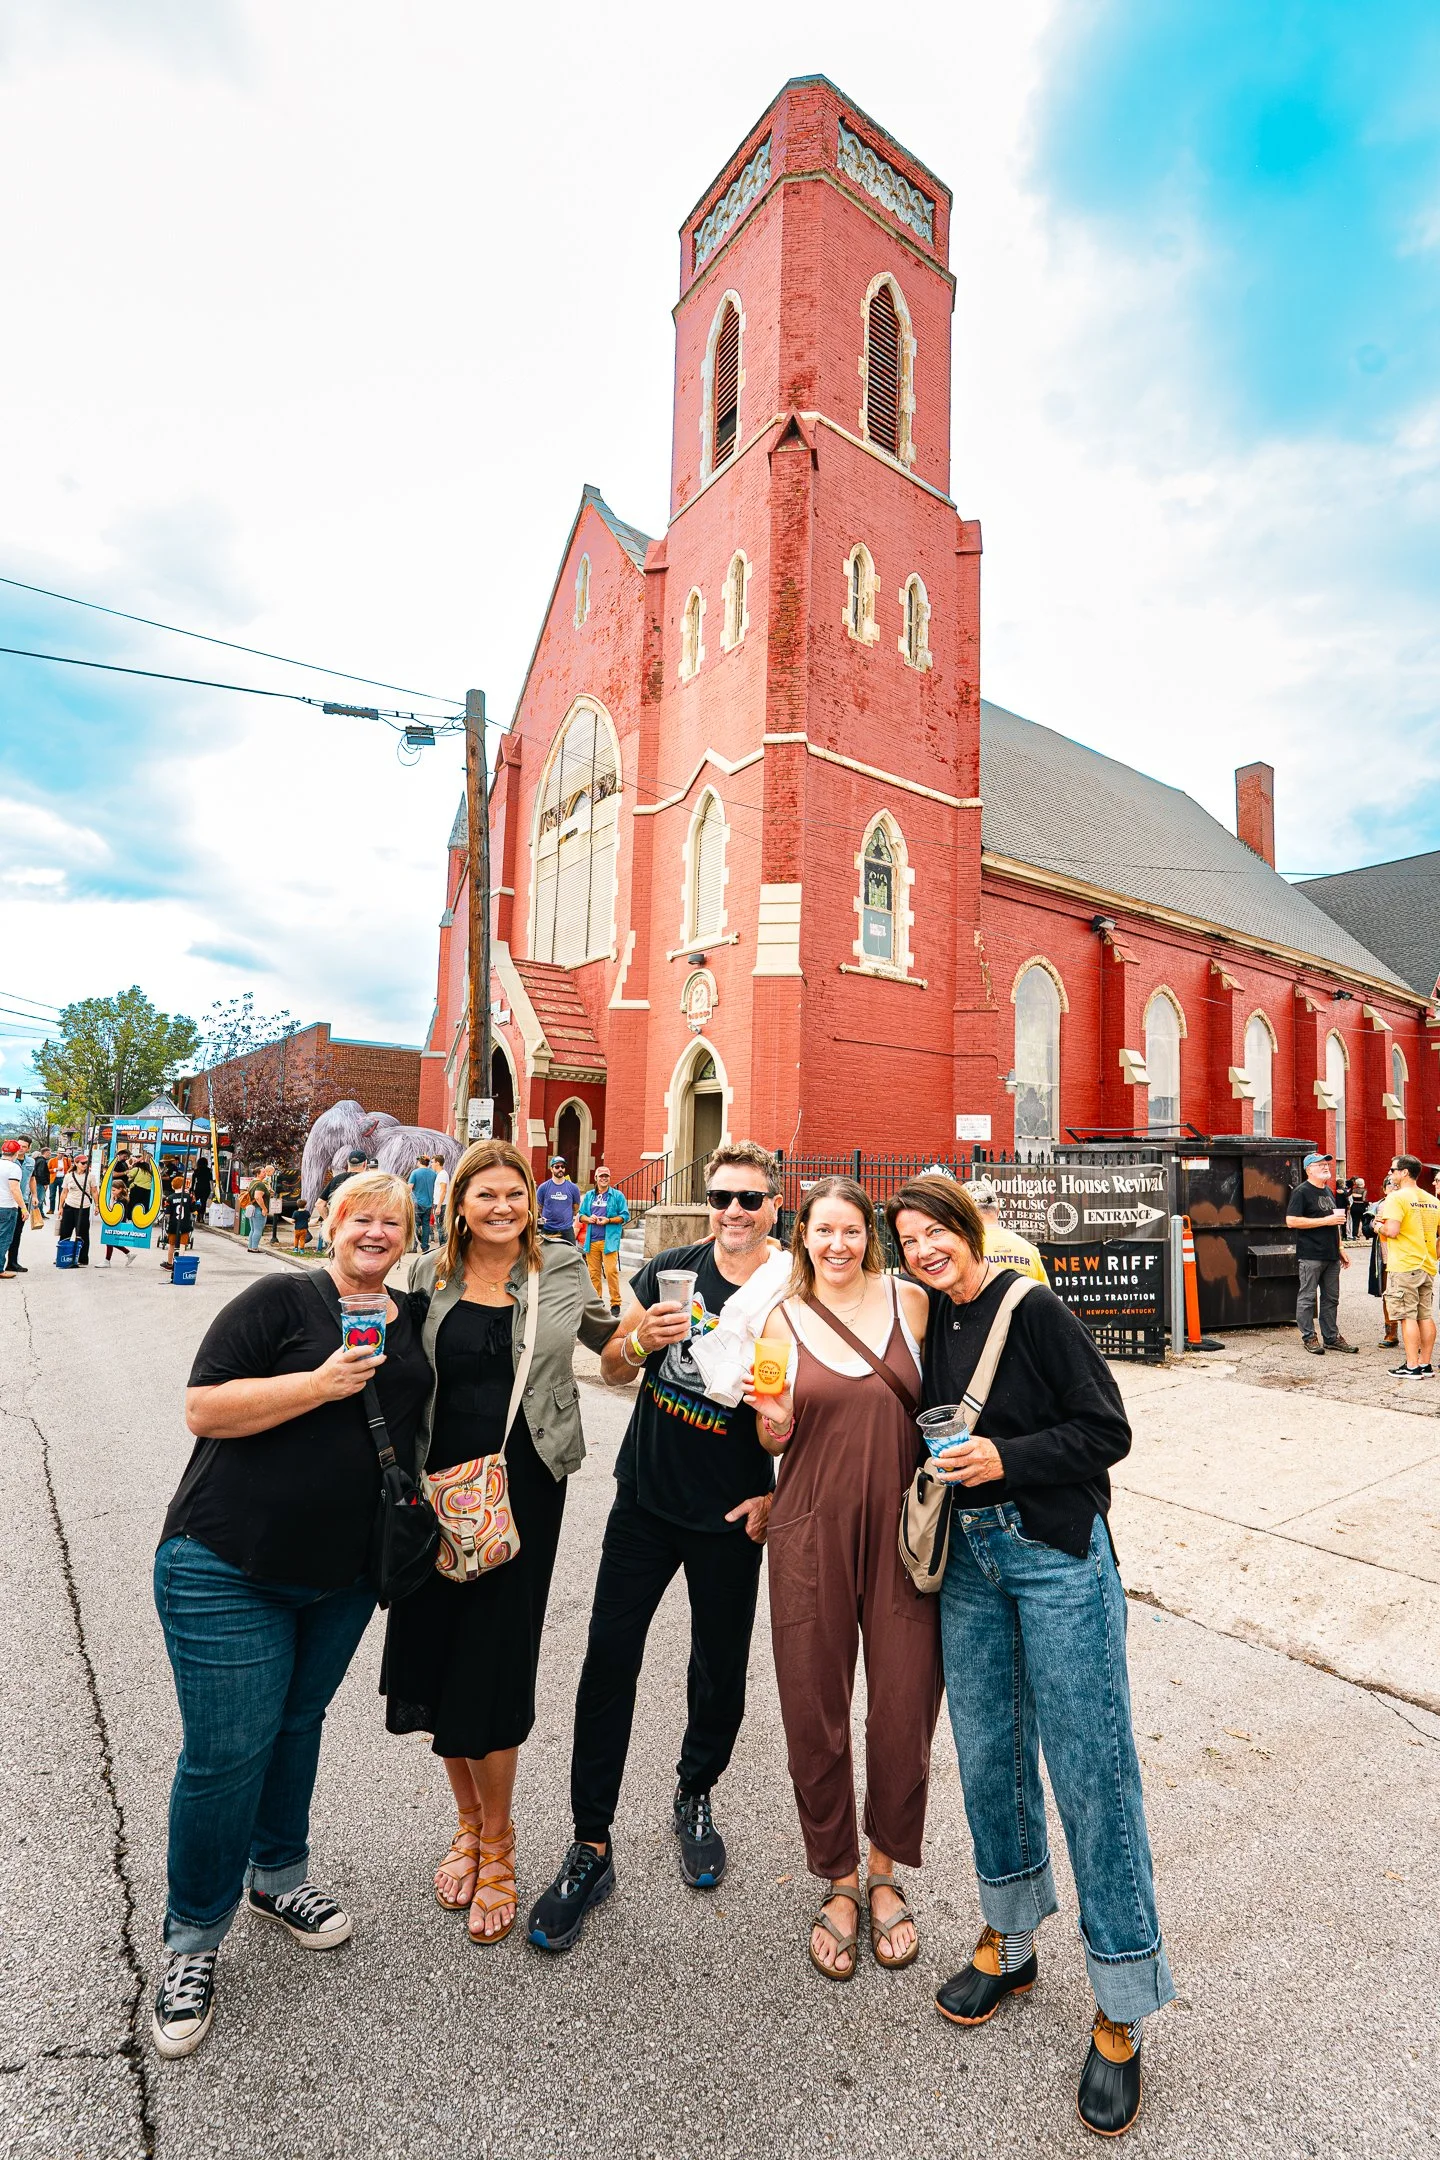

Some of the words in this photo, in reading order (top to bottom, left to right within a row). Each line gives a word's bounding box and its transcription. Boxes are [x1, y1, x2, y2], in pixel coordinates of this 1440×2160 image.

[138, 1129, 208, 1144] DRNKLOTS
[981, 1173, 1057, 1198] Southgate
[1060, 1174, 1110, 1194] House
[1111, 1172, 1164, 1194] Revival
[1010, 1199, 1048, 1210] MUSIC
[1017, 1211, 1046, 1220] BEERS
[1088, 1209, 1153, 1222] ENTRANCE
[1007, 1220, 1045, 1230] SPIRITS
[984, 1255, 1031, 1266] OLUNTEER
[1054, 1256, 1100, 1272] NEW
[1107, 1256, 1155, 1271] RIFF
[1055, 1275, 1139, 1287] DISTILLING
[1083, 1294, 1101, 1302] OLD
[1105, 1293, 1156, 1301] TRADITION
[1121, 1307, 1156, 1315] KENTUCKY
[644, 1374, 733, 1436] PURRIDE
